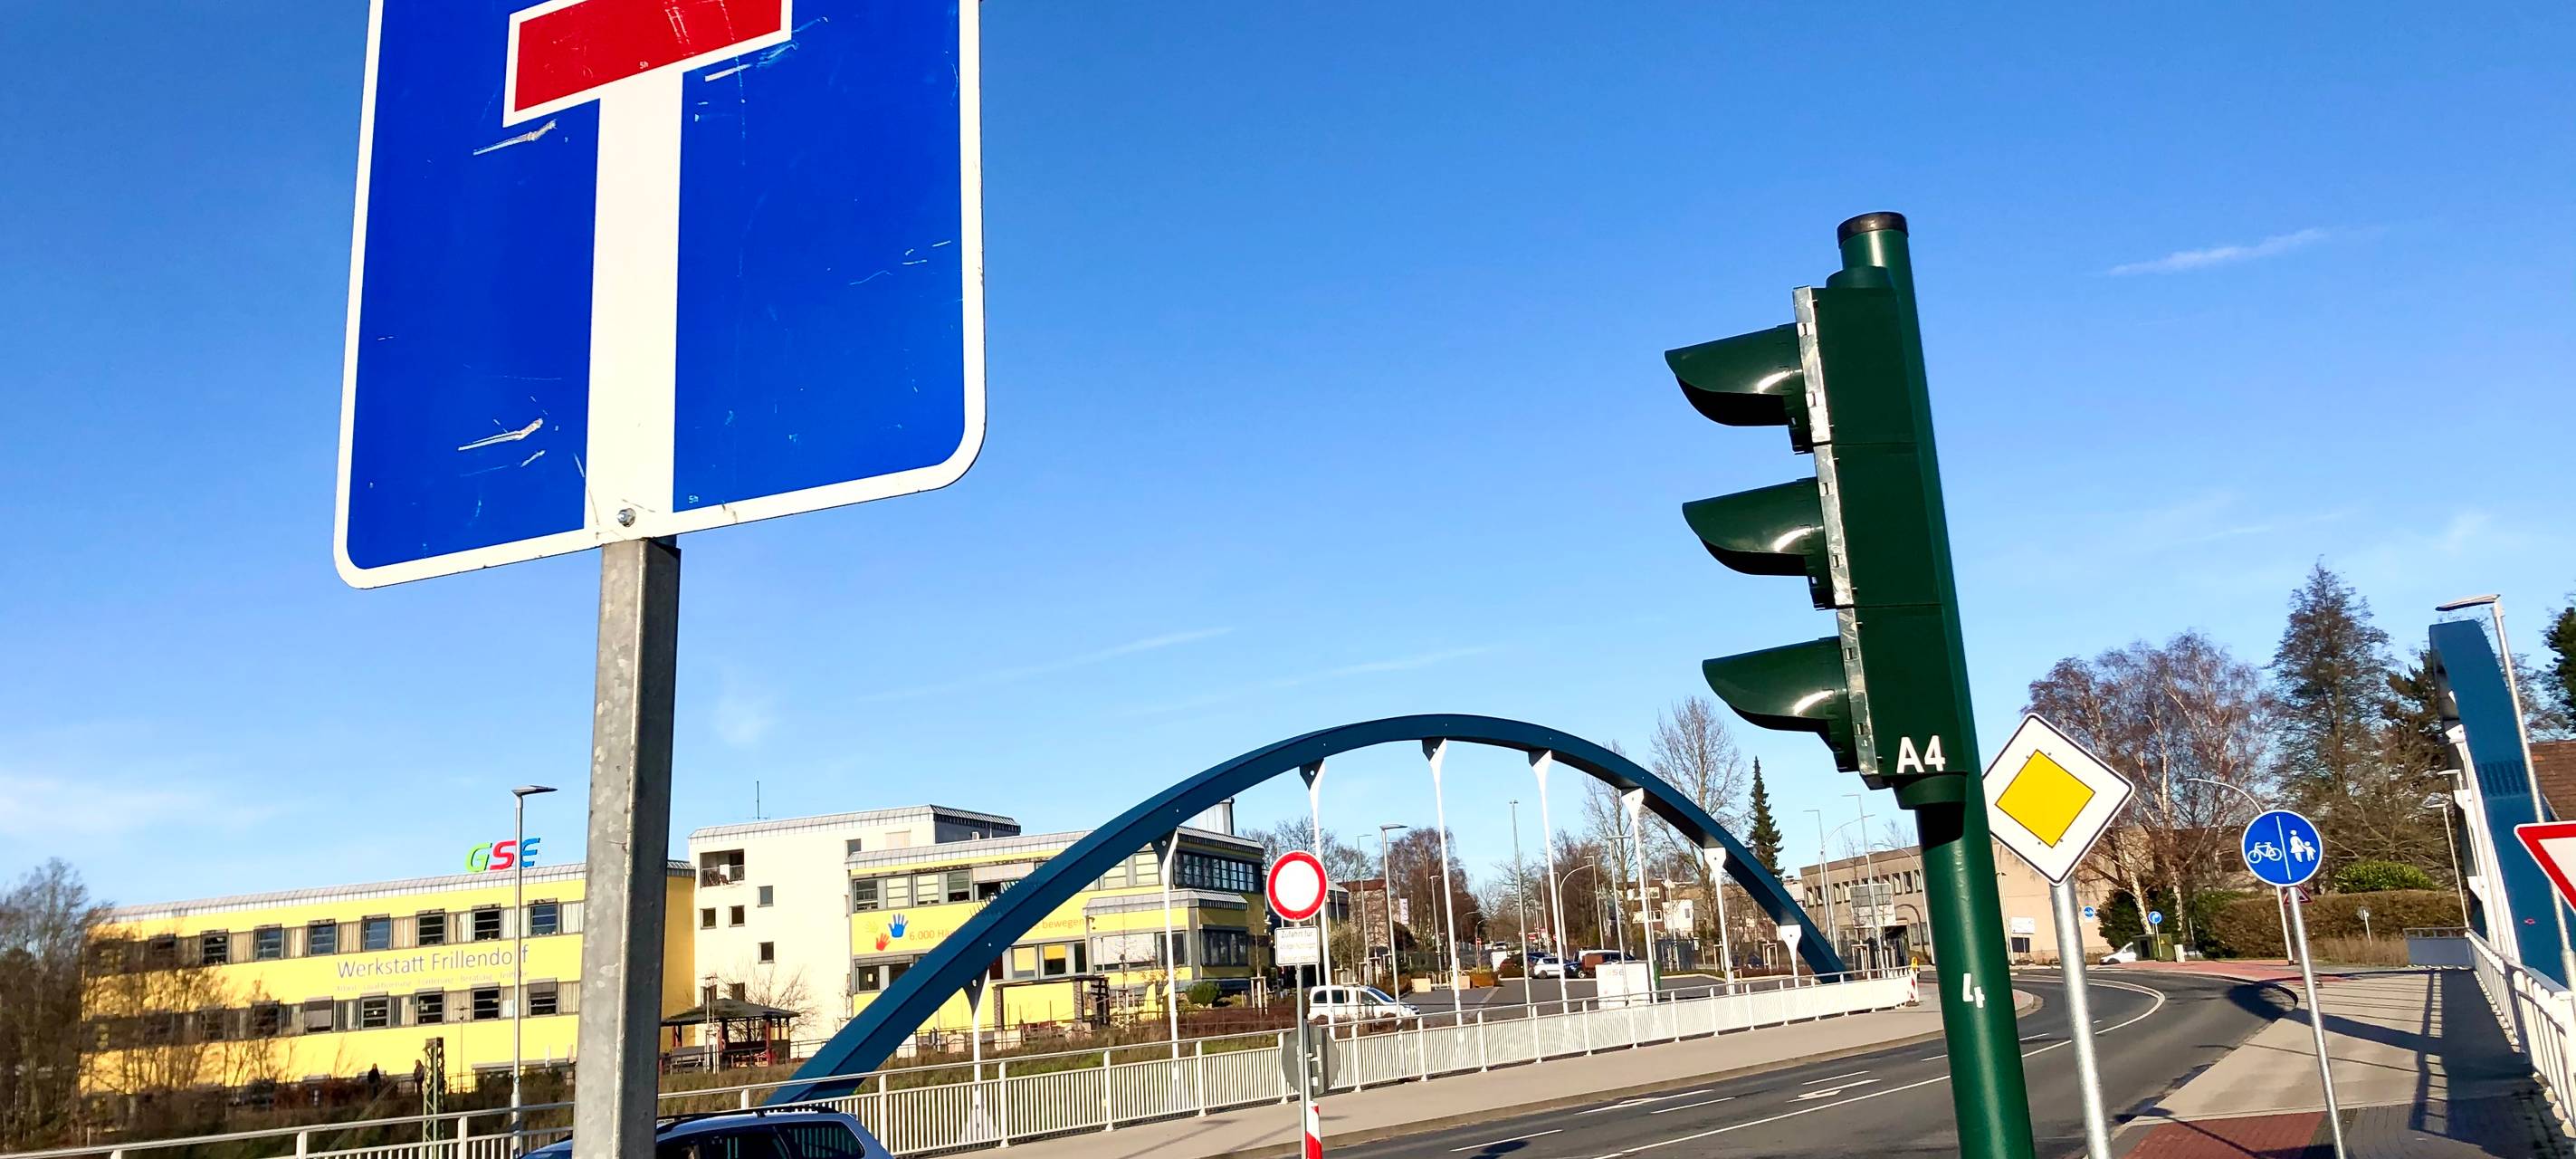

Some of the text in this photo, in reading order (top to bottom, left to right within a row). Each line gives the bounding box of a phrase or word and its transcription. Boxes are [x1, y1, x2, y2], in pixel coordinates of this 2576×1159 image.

[1896, 734, 1946, 773] A4
[465, 838, 540, 872] GSE
[1042, 918, 1085, 930] bewegen
[337, 943, 530, 979] Werkstatt Frillendof
[1962, 972, 1986, 1009] 4
